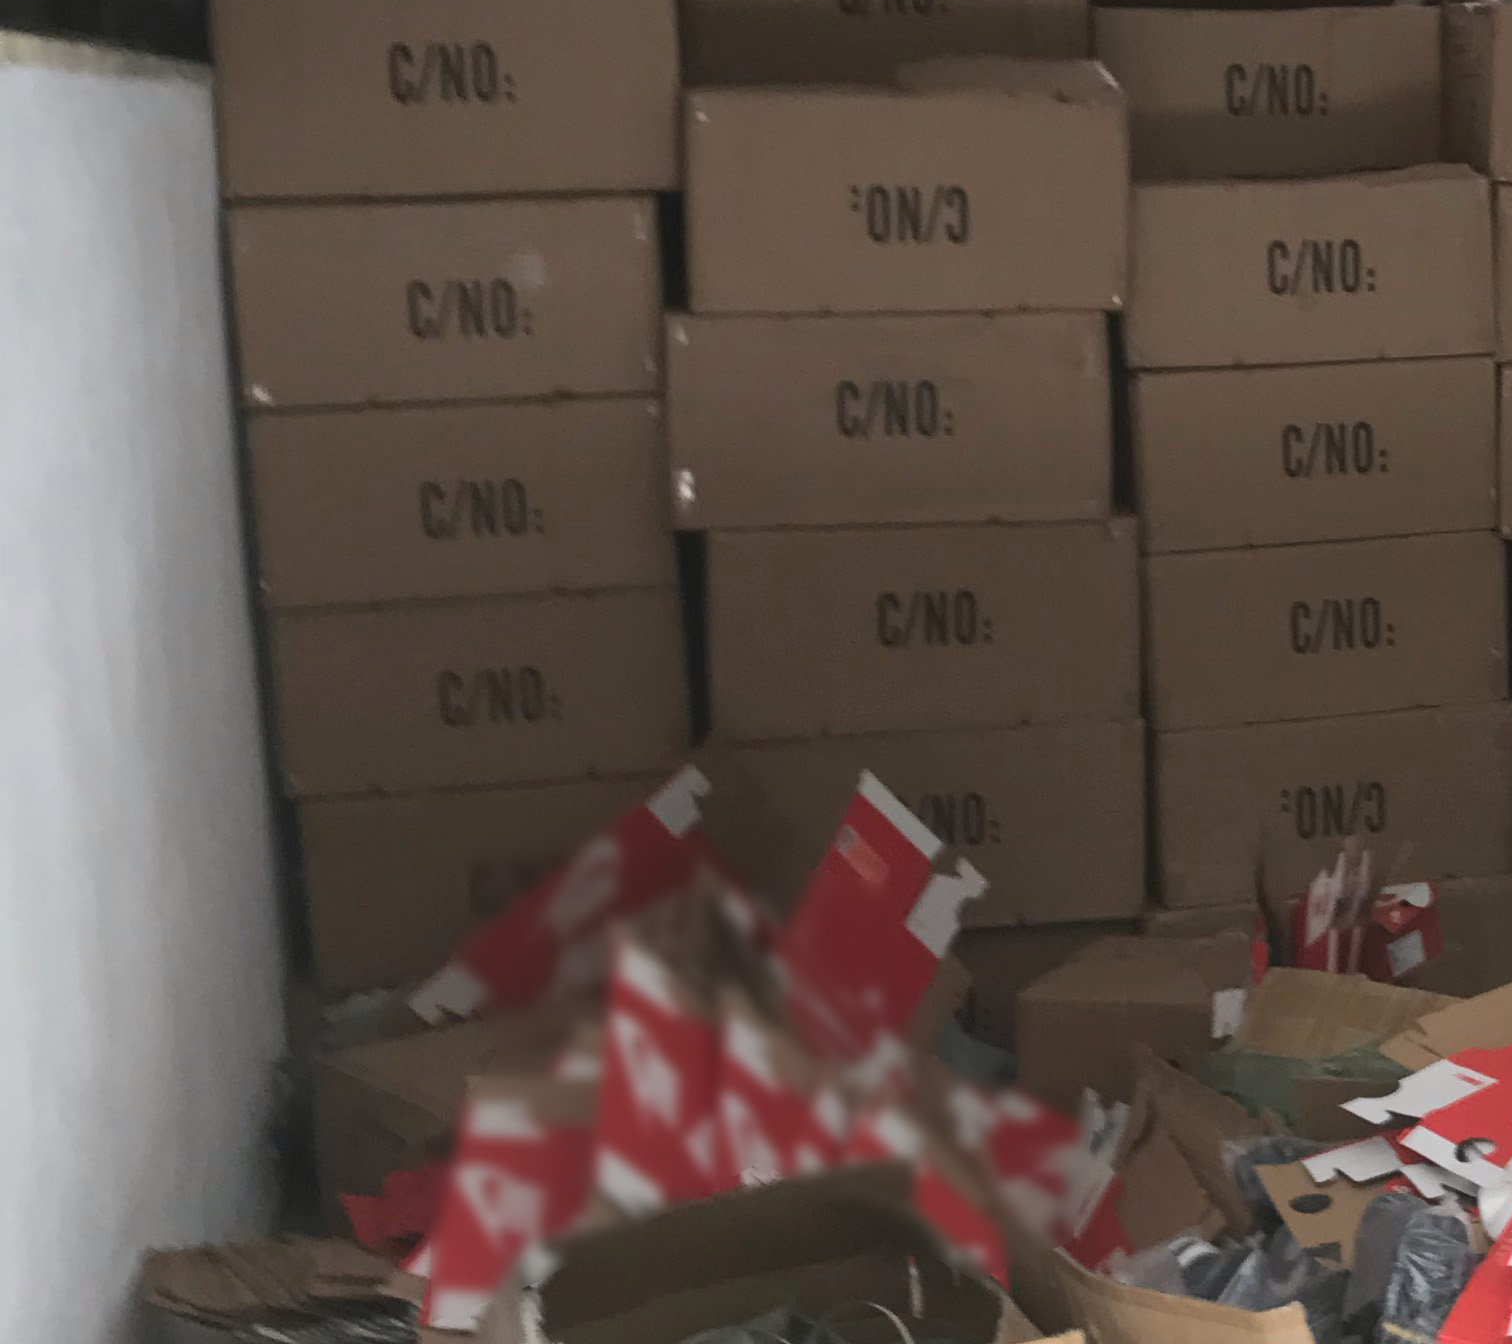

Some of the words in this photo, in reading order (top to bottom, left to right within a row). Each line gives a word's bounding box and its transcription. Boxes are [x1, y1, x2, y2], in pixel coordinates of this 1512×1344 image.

[387, 42, 516, 105] C/NO:
[1224, 63, 1328, 116] C/NO:
[1267, 239, 1377, 296] C/NO:
[406, 278, 533, 340] C/NO:
[837, 379, 954, 438] C/NO:
[1282, 421, 1389, 477] C/NO:
[876, 589, 994, 648] C/NO:
[1290, 597, 1396, 654] C/NO:
